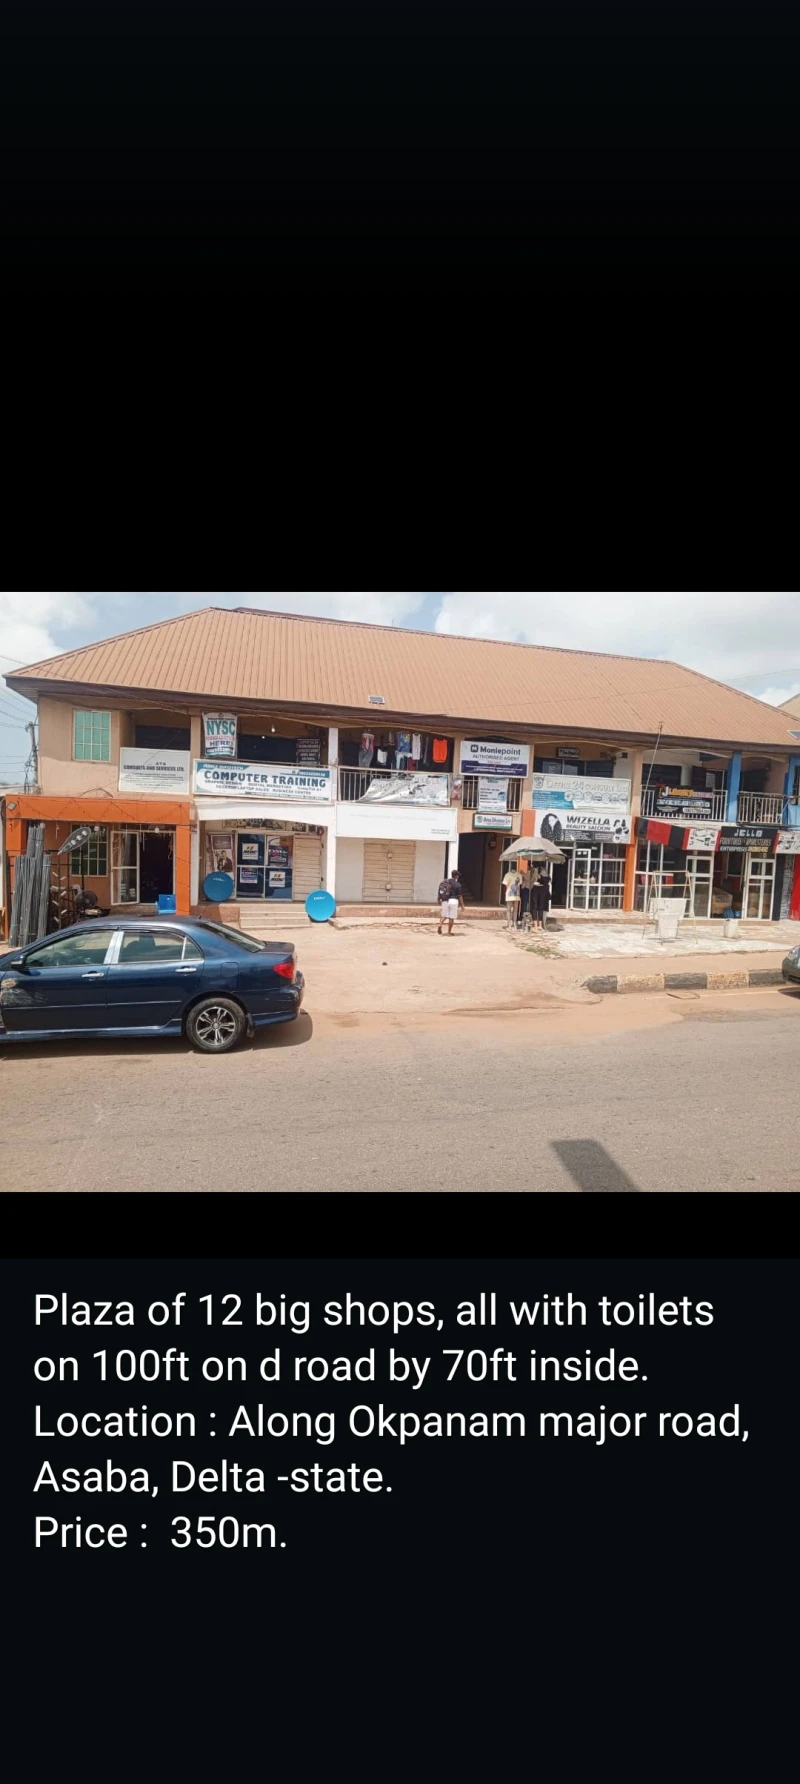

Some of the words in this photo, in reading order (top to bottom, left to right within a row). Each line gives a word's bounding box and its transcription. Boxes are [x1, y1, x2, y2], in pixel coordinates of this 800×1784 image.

[206, 720, 236, 736] NYSC
[480, 746, 521, 756] Moniepoint
[204, 770, 268, 784] COMPUTER
[272, 775, 326, 788] TRAINING
[572, 780, 584, 791] 24
[566, 815, 610, 826] WIZELLA
[734, 829, 763, 837] JELLO
